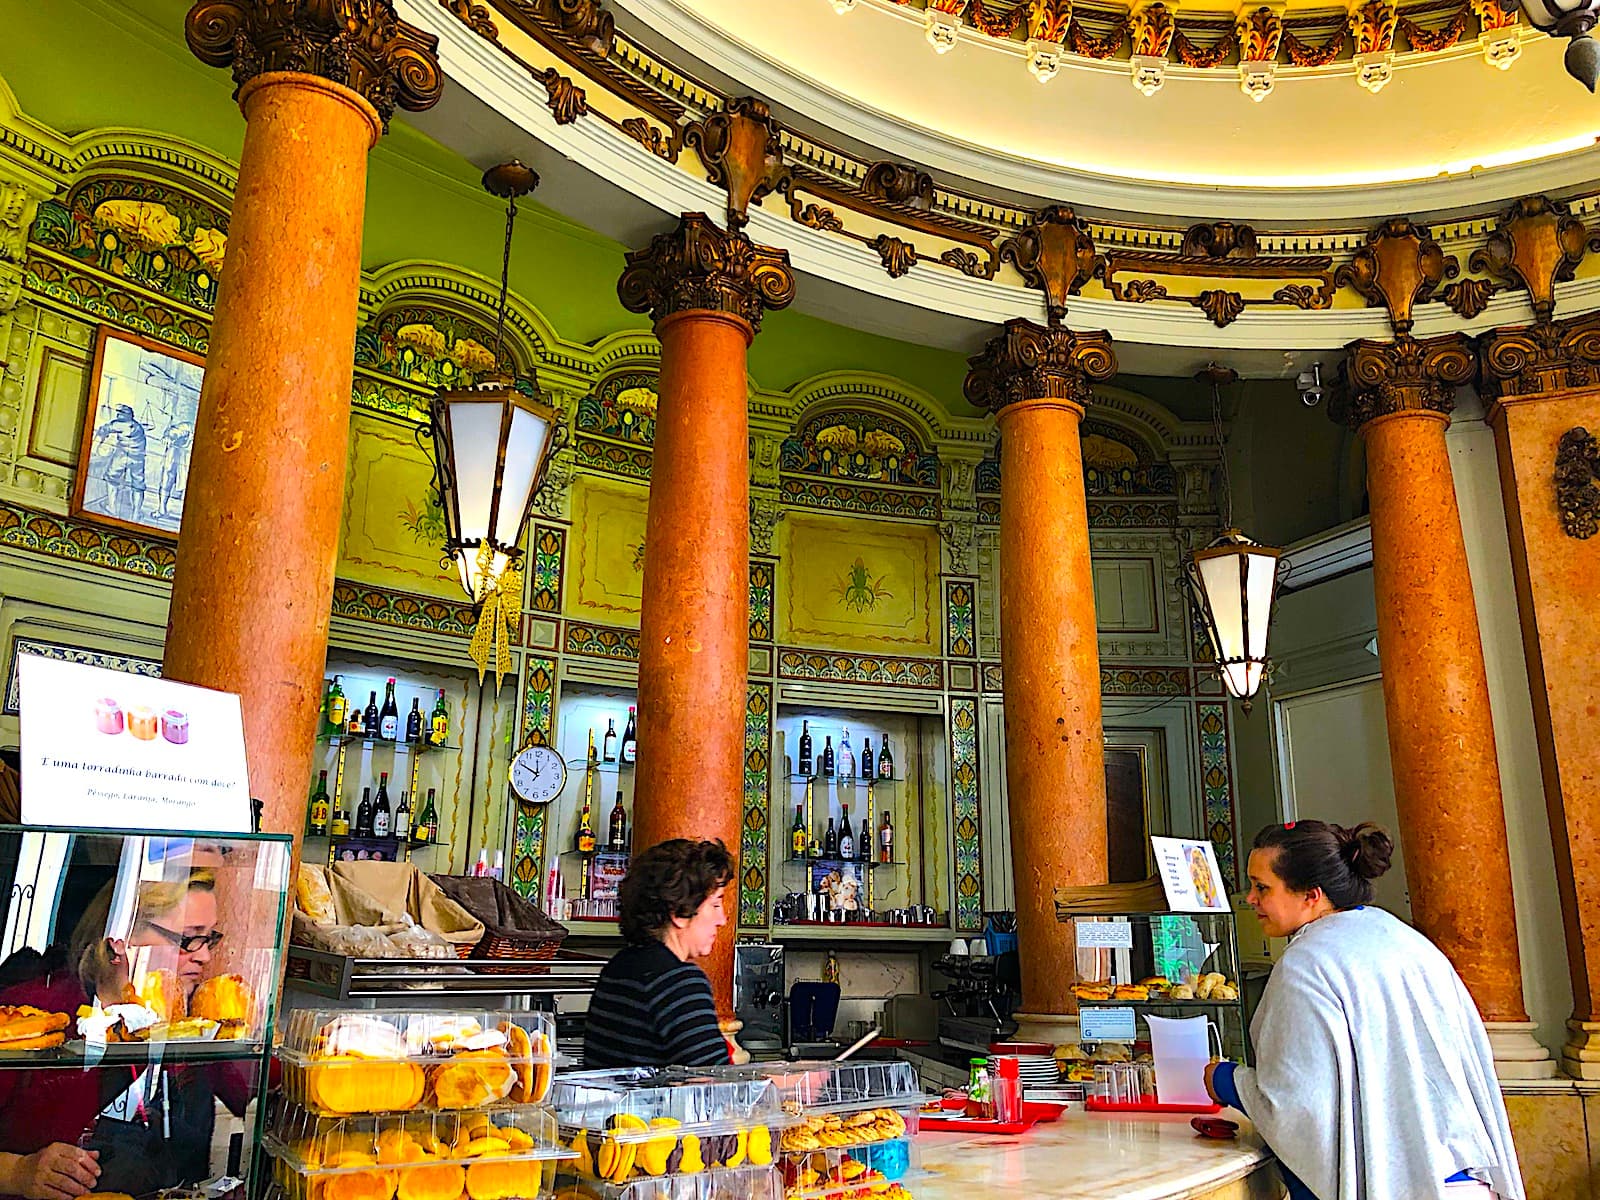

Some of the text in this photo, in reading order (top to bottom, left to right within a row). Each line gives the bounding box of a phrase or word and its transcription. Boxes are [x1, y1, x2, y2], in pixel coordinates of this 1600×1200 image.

[526, 752, 532, 760] 11
[535, 750, 543, 758] 12
[53, 759, 78, 769] uma
[551, 762, 558, 770] 2
[532, 791, 539, 799] 6
[542, 789, 549, 797] 5
